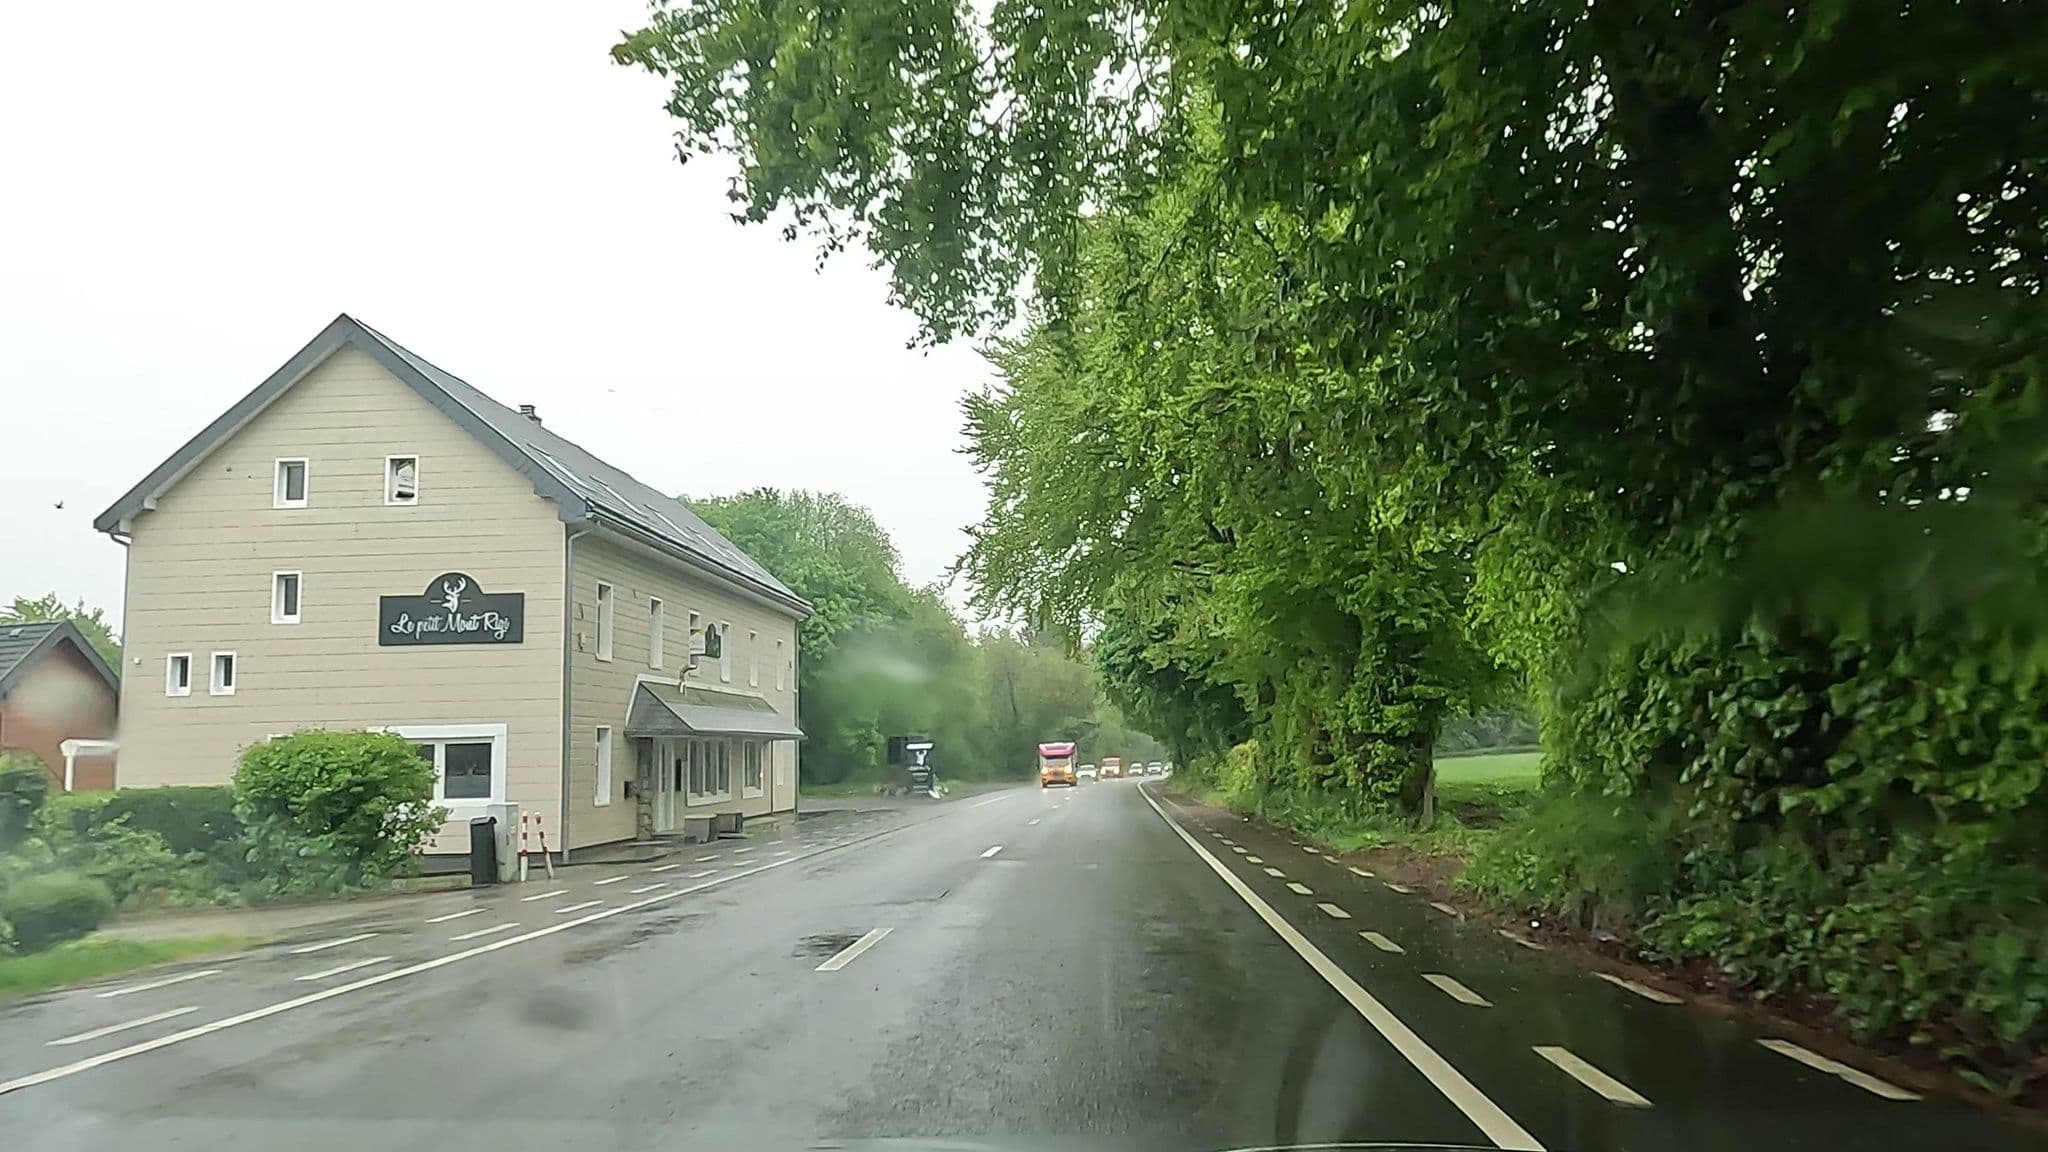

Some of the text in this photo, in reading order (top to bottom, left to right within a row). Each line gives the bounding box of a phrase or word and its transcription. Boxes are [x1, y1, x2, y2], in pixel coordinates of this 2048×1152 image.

[390, 612, 510, 640] Le petit Mont Rigi
